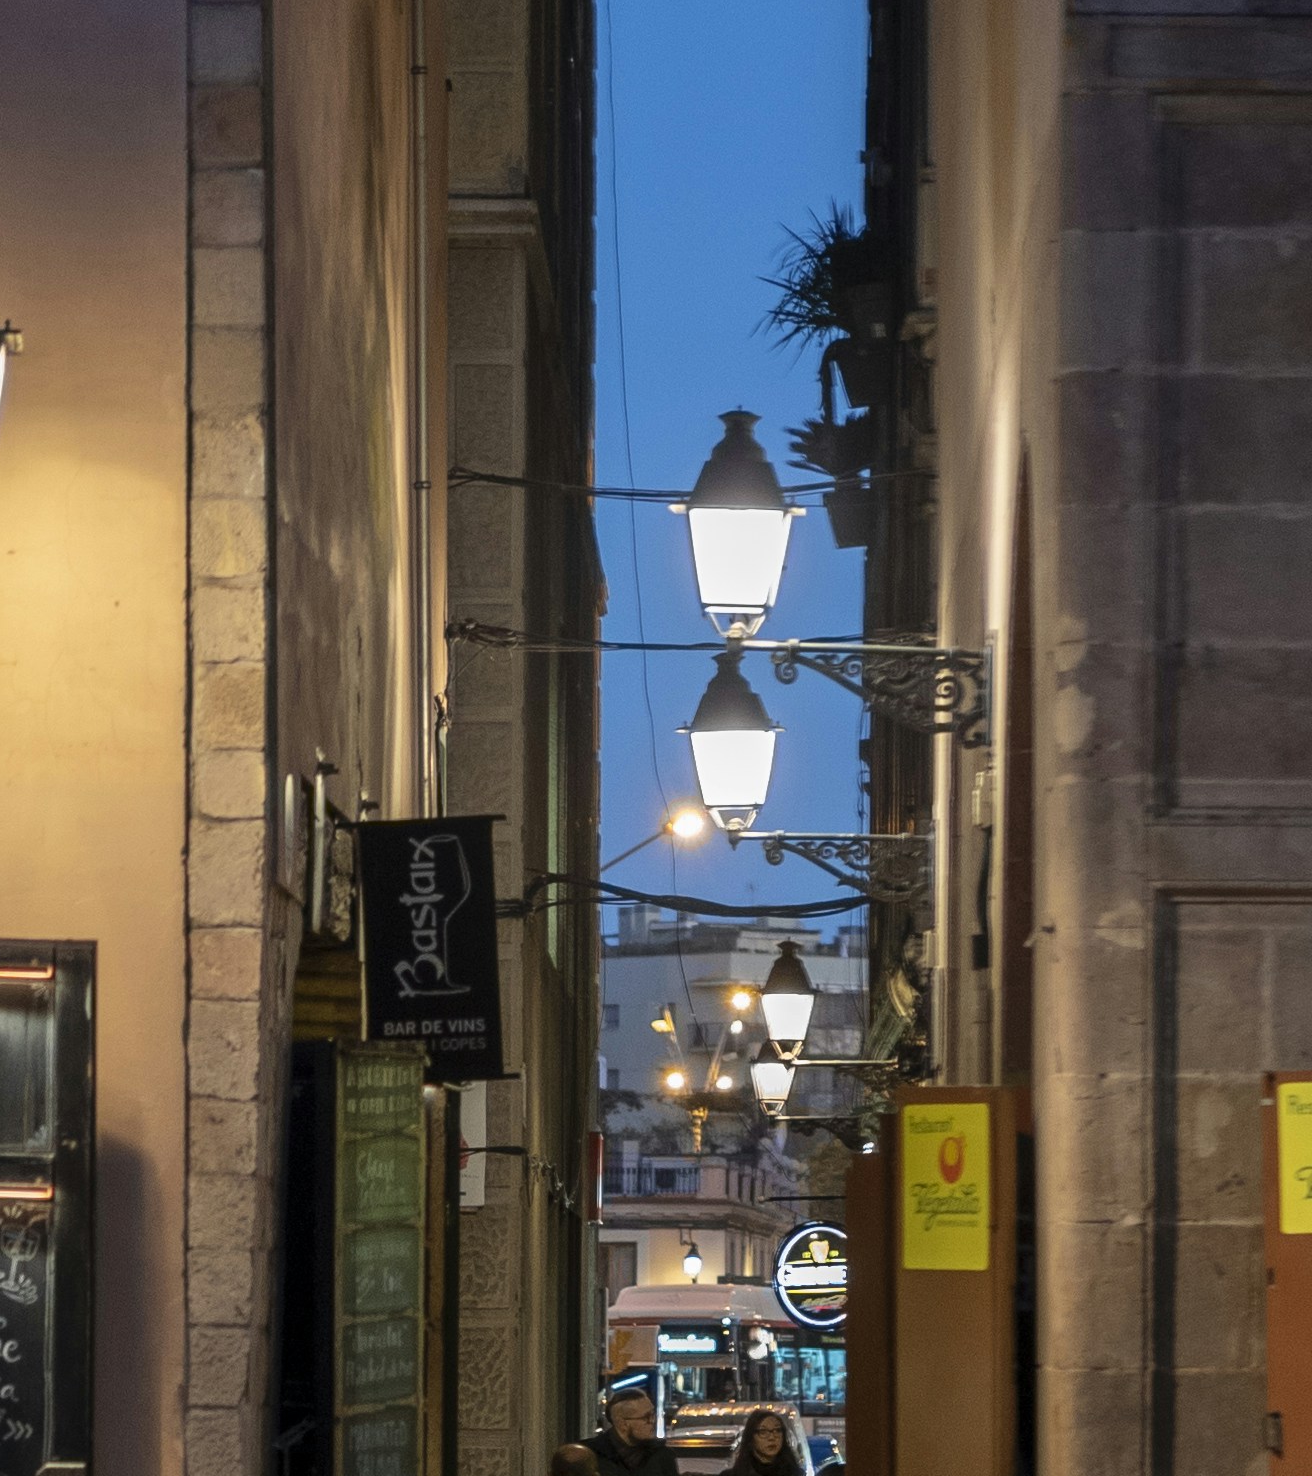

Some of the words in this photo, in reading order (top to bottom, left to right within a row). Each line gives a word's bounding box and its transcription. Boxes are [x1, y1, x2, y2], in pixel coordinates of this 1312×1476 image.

[393, 836, 445, 998] Bastaix
[383, 1022, 416, 1036] BAR
[421, 1020, 442, 1035] DE
[448, 1018, 486, 1033] VINS
[440, 1037, 487, 1052] COPES
